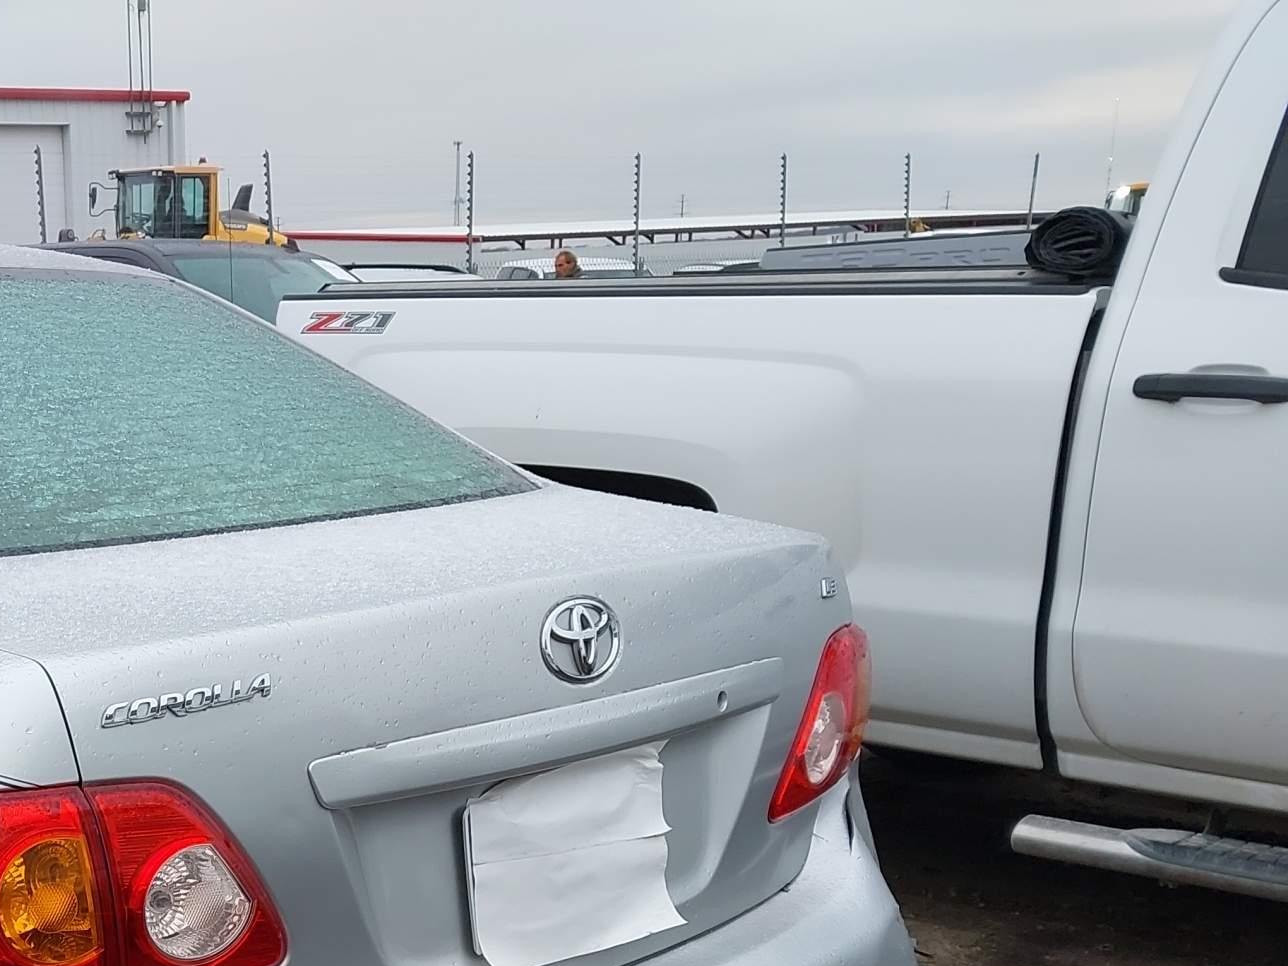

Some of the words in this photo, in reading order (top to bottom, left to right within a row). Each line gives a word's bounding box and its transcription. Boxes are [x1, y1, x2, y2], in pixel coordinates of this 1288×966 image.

[300, 311, 397, 335] Z71
[820, 576, 838, 599] LE
[101, 672, 272, 729] COROLLA
